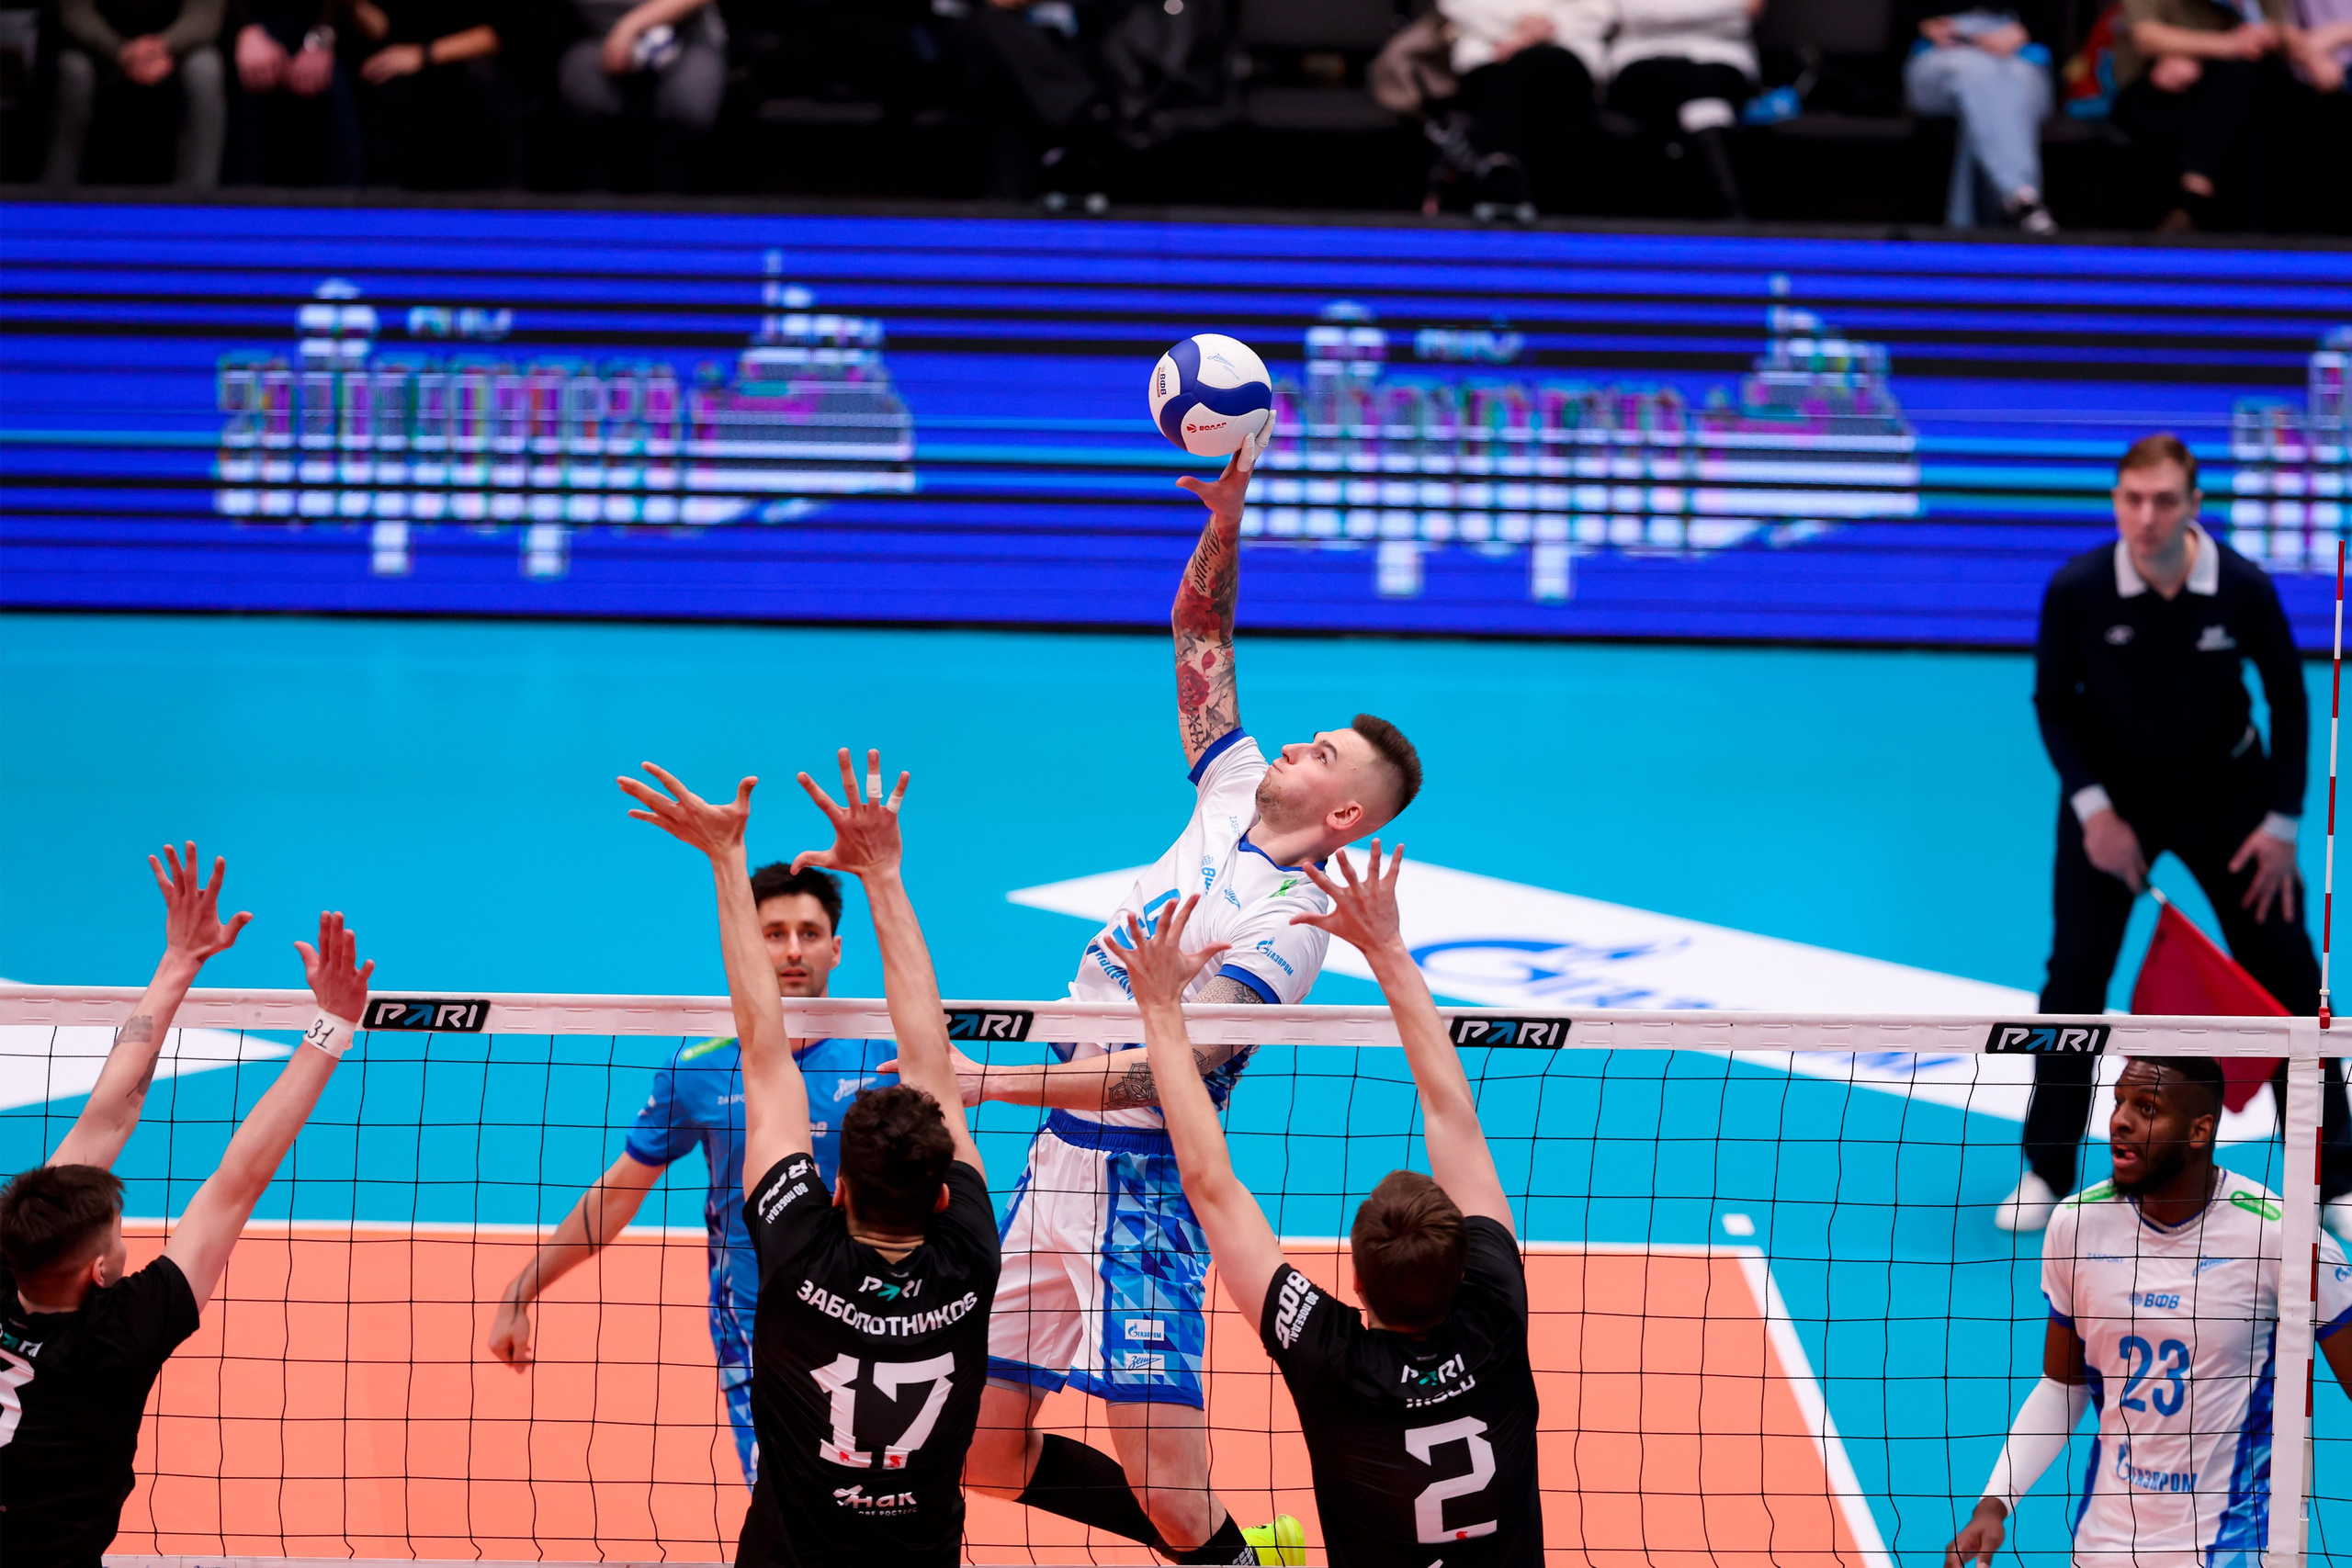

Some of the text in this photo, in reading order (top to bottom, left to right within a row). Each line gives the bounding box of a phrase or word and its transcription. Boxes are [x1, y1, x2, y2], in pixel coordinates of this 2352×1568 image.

[374, 1003, 478, 1028] PARI
[1456, 1021, 1560, 1045] PARI
[308, 1020, 334, 1049] 31
[1996, 1028, 2100, 1052] PARI
[765, 1182, 808, 1224] 80 ПОБЕДА!
[1289, 1292, 1319, 1342] 80 ПОБЕДА!
[2143, 1293, 2180, 1309] ВФВ
[2120, 1336, 2190, 1416] 23
[809, 1351, 956, 1469] 17
[1405, 1416, 1498, 1543] 2
